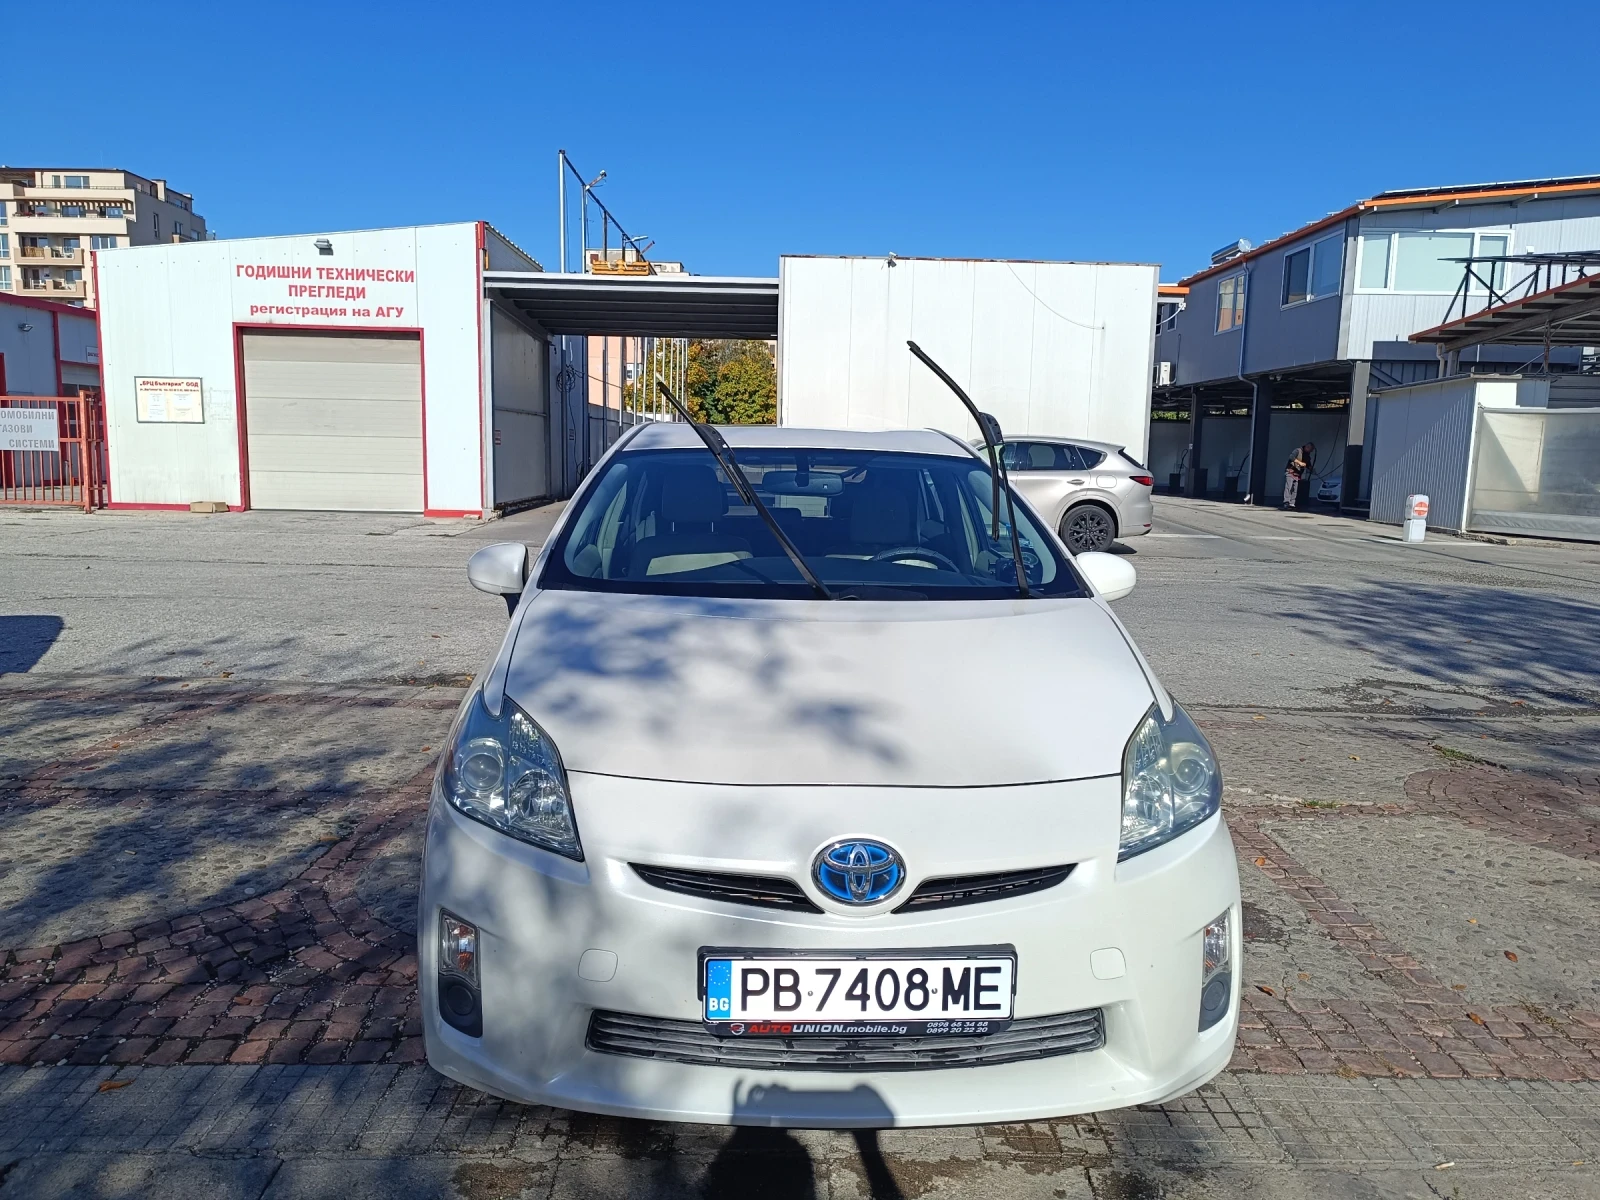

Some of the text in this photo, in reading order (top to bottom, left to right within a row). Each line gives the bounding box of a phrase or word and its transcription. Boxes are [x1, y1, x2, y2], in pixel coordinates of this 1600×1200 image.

[236, 264, 415, 283] ГОДИШНИ ТЕХНИЧЕСКИ
[288, 284, 366, 301] ПРЕГЛЕДИ
[250, 304, 404, 318] регистрация на АГУ
[9, 439, 55, 449] СИСТЕМИ
[740, 966, 1002, 1012] PB 7408 ME
[709, 997, 730, 1011] BG
